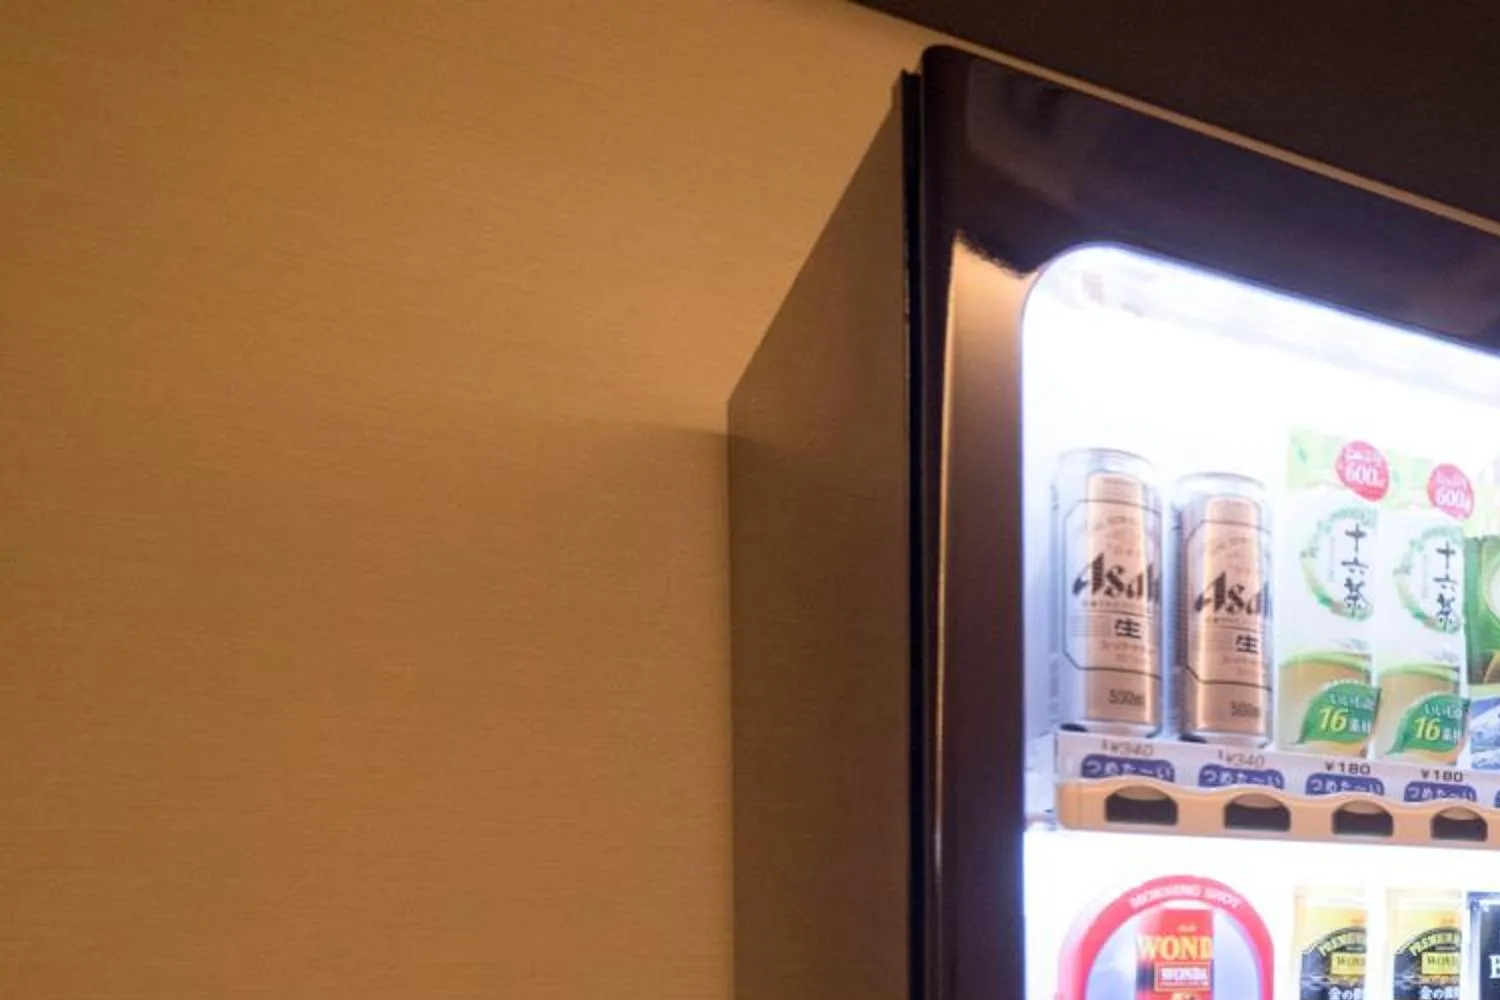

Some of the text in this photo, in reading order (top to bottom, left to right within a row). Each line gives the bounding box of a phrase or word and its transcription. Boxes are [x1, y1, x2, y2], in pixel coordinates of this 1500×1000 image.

[1114, 618, 1142, 639] 生
[1235, 635, 1259, 654] 生
[1320, 706, 1349, 732] 16
[1414, 717, 1442, 741] 16
[1325, 762, 1371, 775] ¥180
[1421, 769, 1464, 783] ¥180
